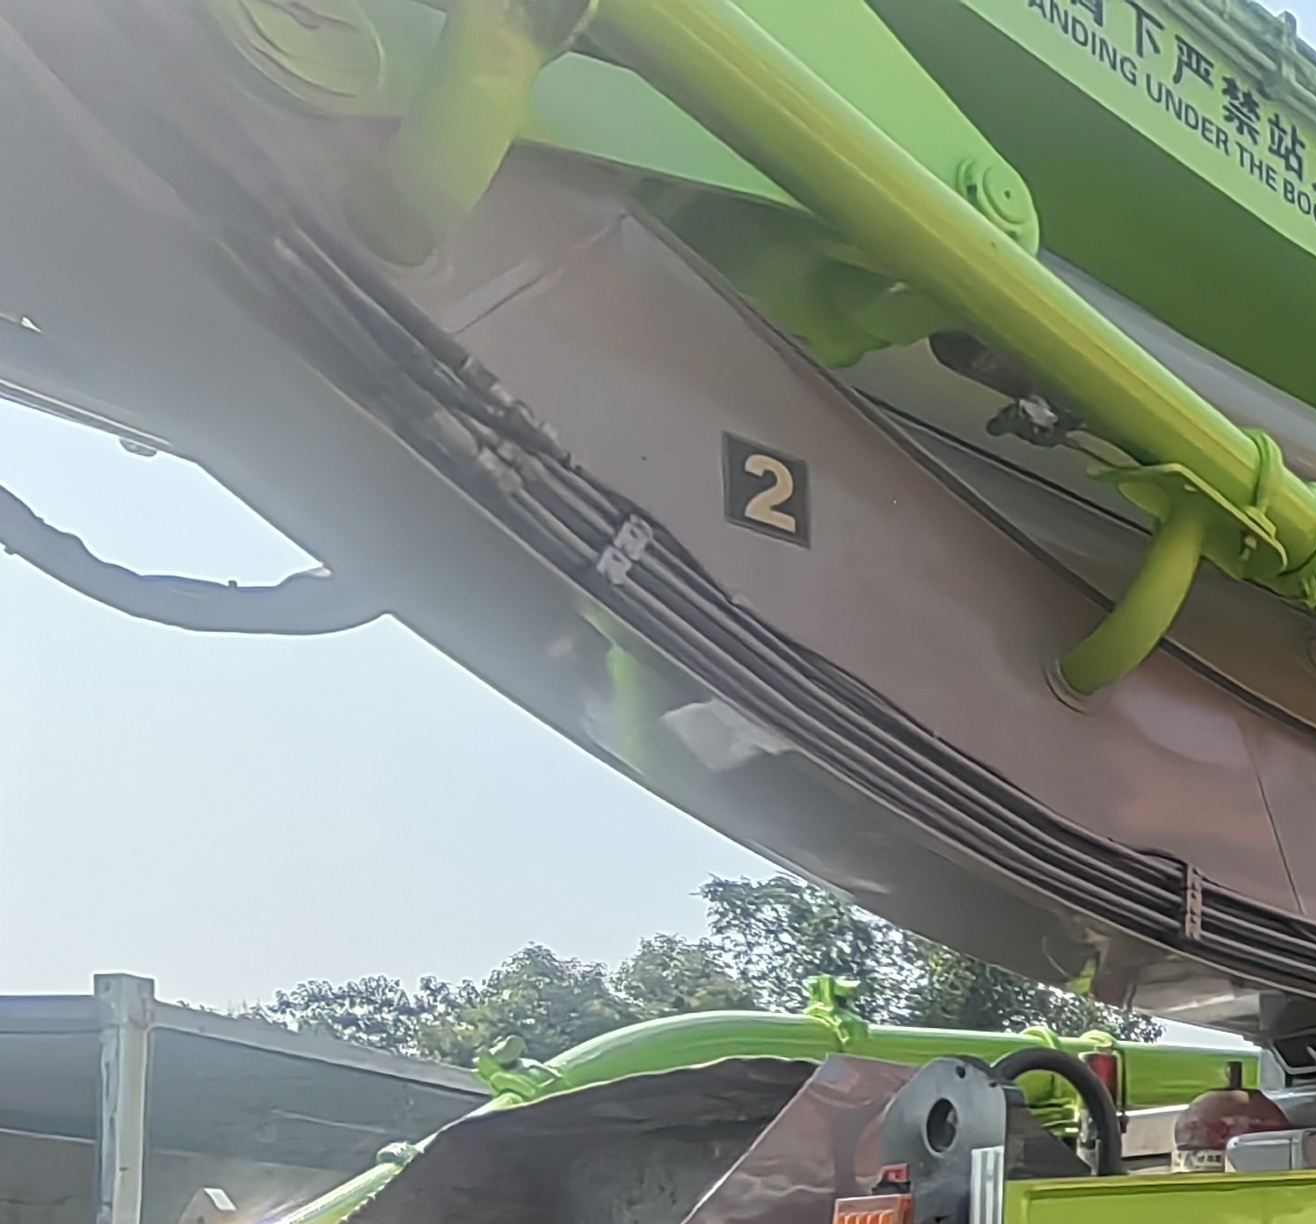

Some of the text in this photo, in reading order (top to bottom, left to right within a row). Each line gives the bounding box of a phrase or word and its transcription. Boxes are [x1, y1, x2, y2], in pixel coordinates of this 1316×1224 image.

[1146, 73, 1230, 157] UNDER
[1235, 141, 1278, 192] THE
[744, 453, 796, 534] 2
